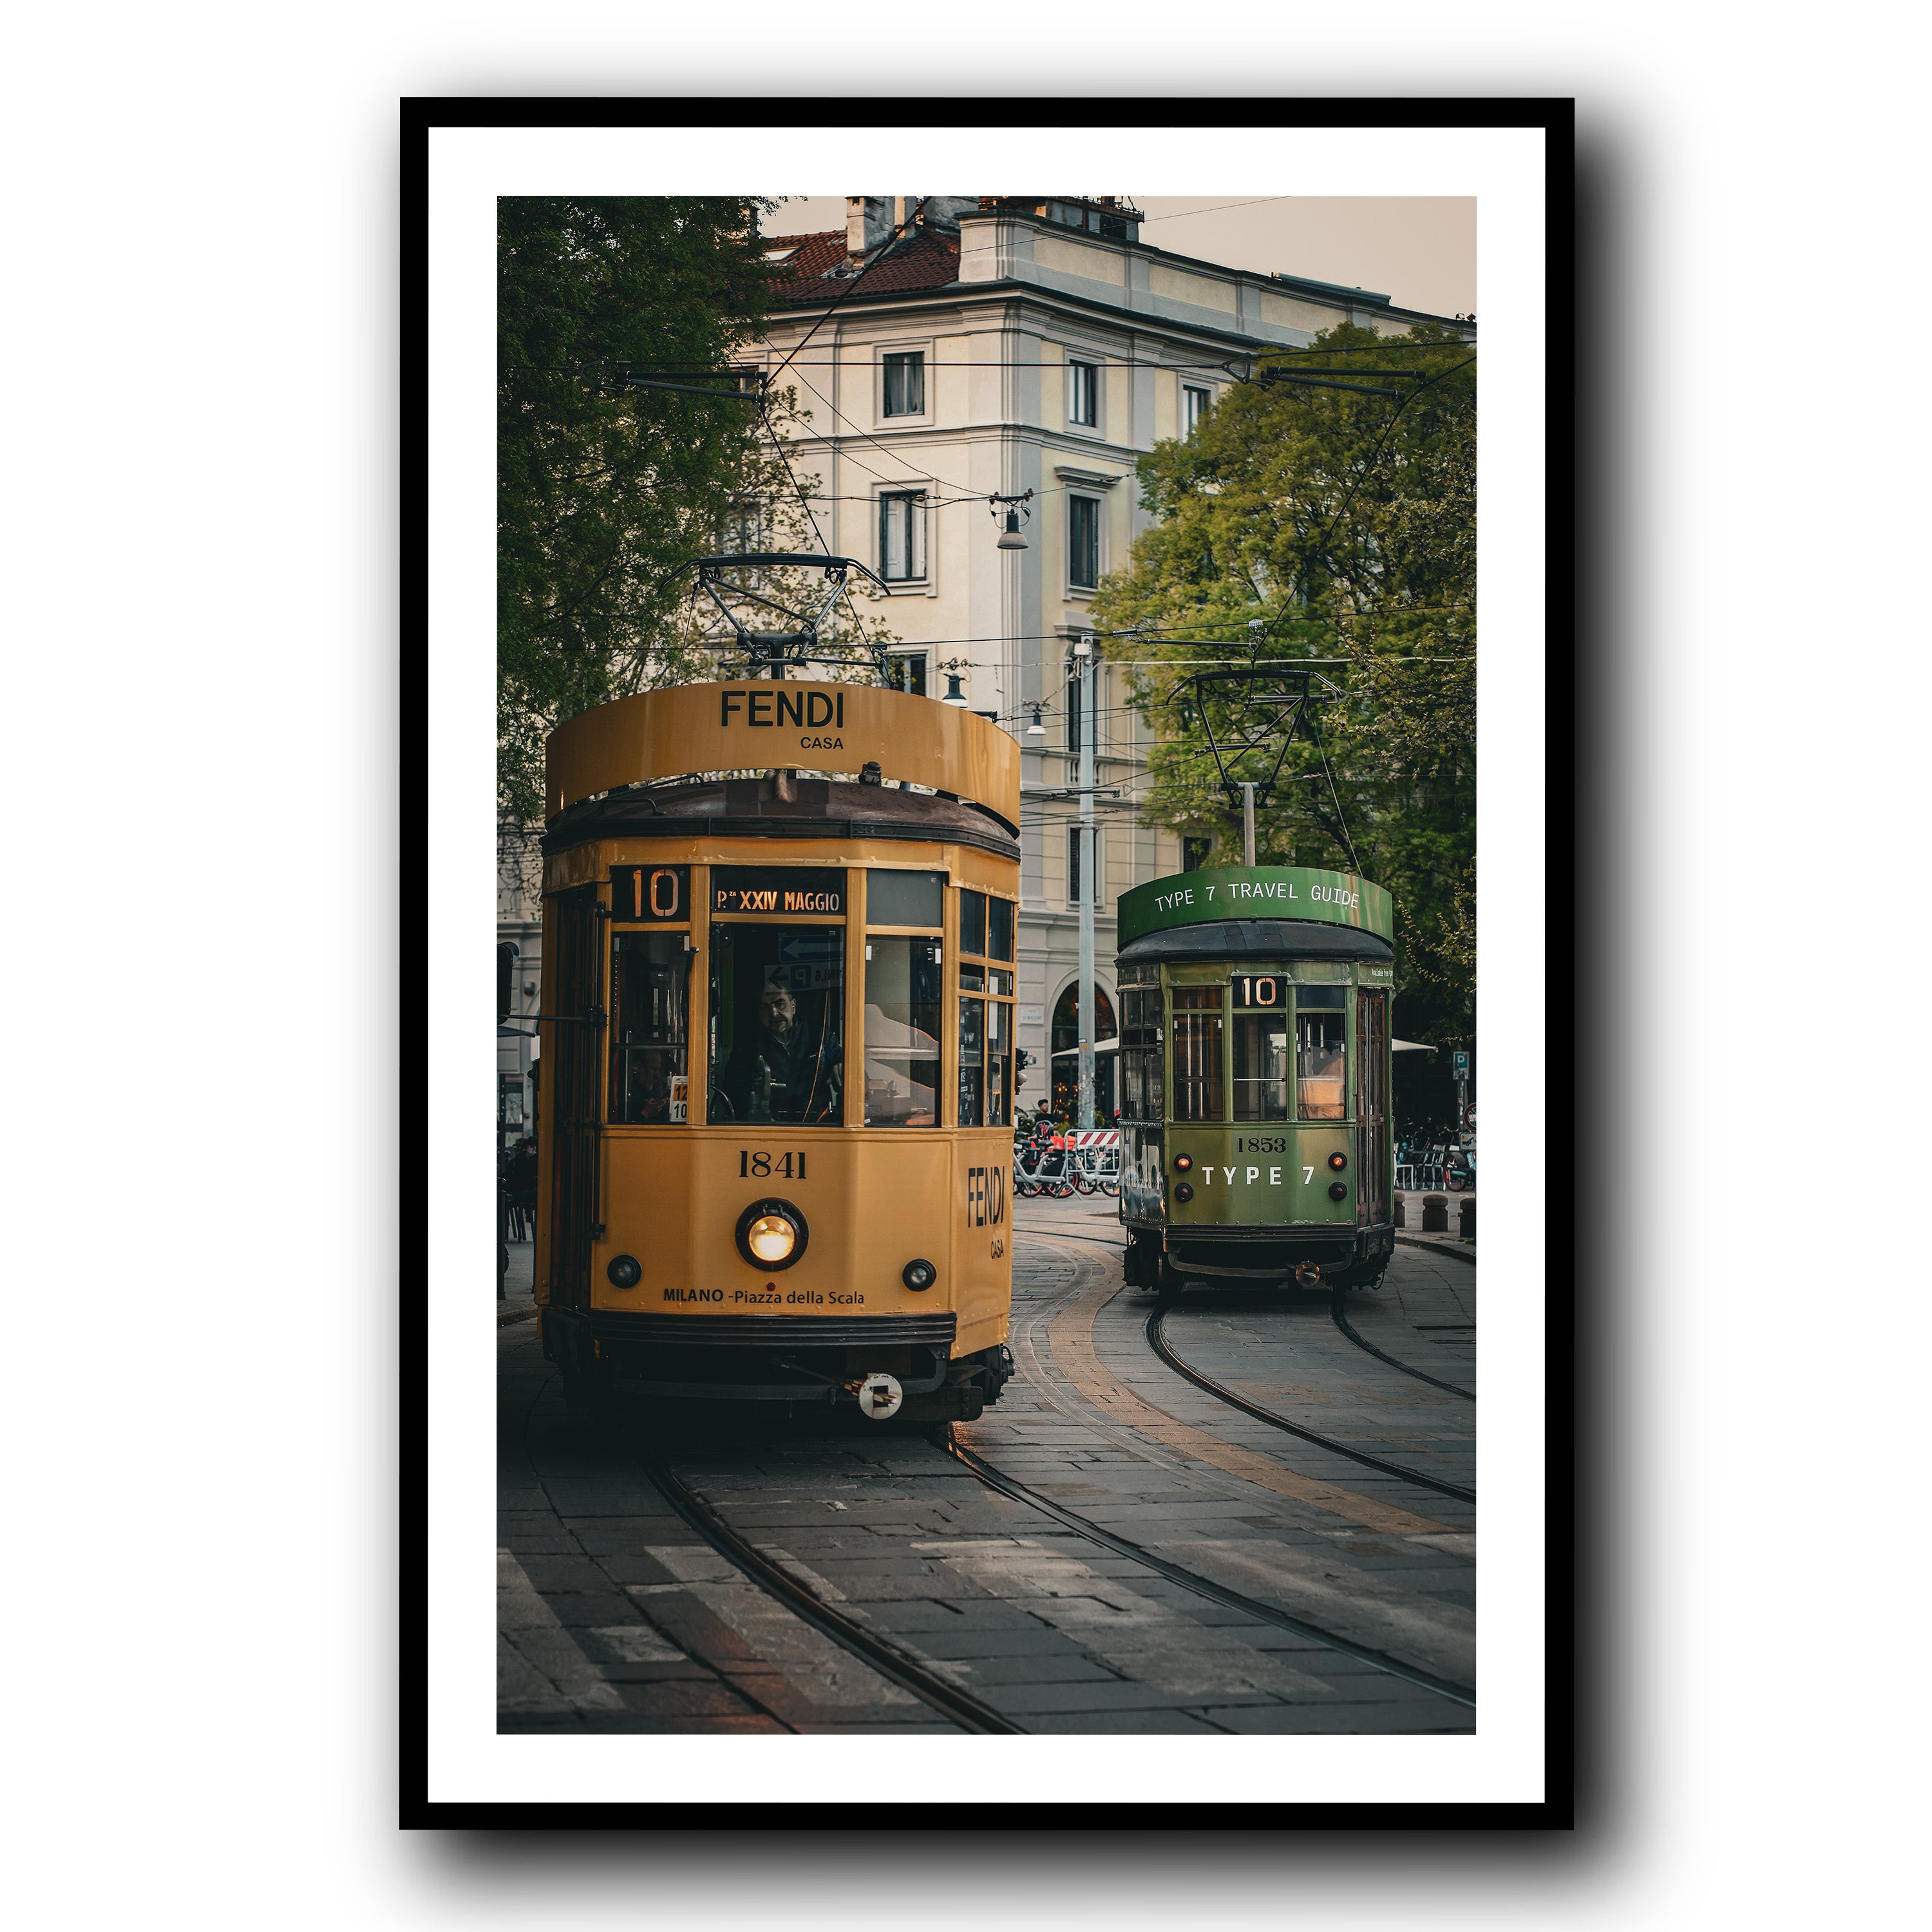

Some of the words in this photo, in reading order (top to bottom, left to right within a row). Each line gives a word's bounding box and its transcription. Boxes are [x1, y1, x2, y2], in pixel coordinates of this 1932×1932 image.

[721, 690, 844, 728] FENDI
[800, 737, 844, 750] CASA
[633, 869, 679, 918] 10
[739, 891, 778, 910] XXIV
[784, 892, 840, 912] MAGGIO
[1155, 889, 1195, 912] TYPE
[1206, 886, 1215, 902] 7
[1228, 883, 1298, 899] TRAVEL
[1311, 885, 1359, 909] GUIDE
[1242, 978, 1276, 1005] 10
[676, 1085, 688, 1101] 12
[674, 1103, 687, 1119] 10
[1237, 1138, 1287, 1153] 1853
[739, 1150, 807, 1179] 1841
[1202, 1166, 1282, 1185] TYPE
[1302, 1166, 1314, 1185] 7
[968, 1166, 1005, 1228] FENDI
[990, 1239, 1005, 1260] CASA
[663, 1289, 724, 1302] MILANO
[786, 1291, 824, 1304] della
[828, 1291, 864, 1304] Scala
